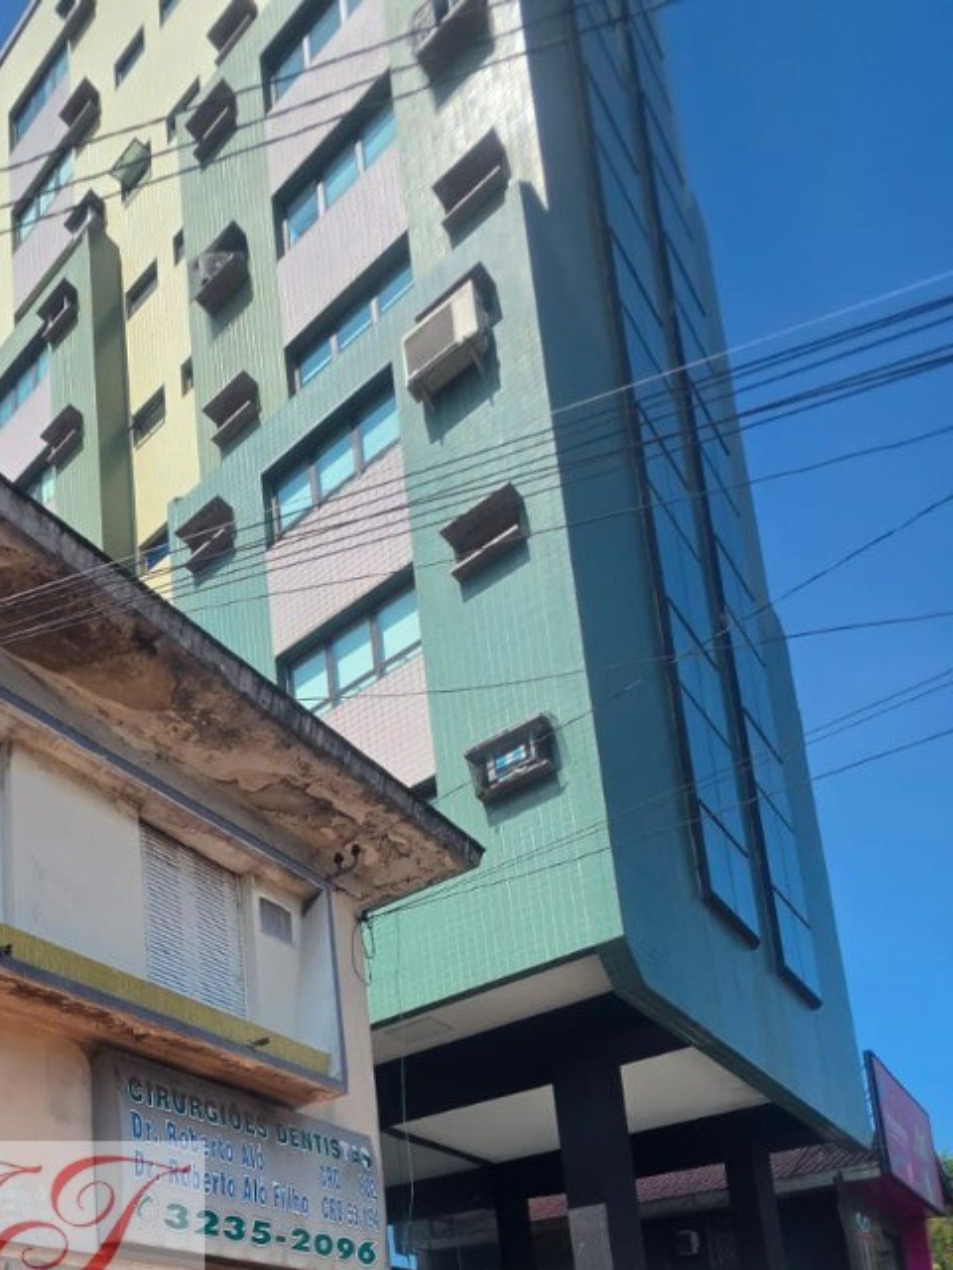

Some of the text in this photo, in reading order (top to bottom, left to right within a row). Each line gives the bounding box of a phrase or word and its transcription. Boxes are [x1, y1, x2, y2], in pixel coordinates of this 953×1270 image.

[130, 1110, 158, 1141] Dr.
[165, 1118, 234, 1164] Roberto
[163, 1203, 377, 1265] 3235-2096
